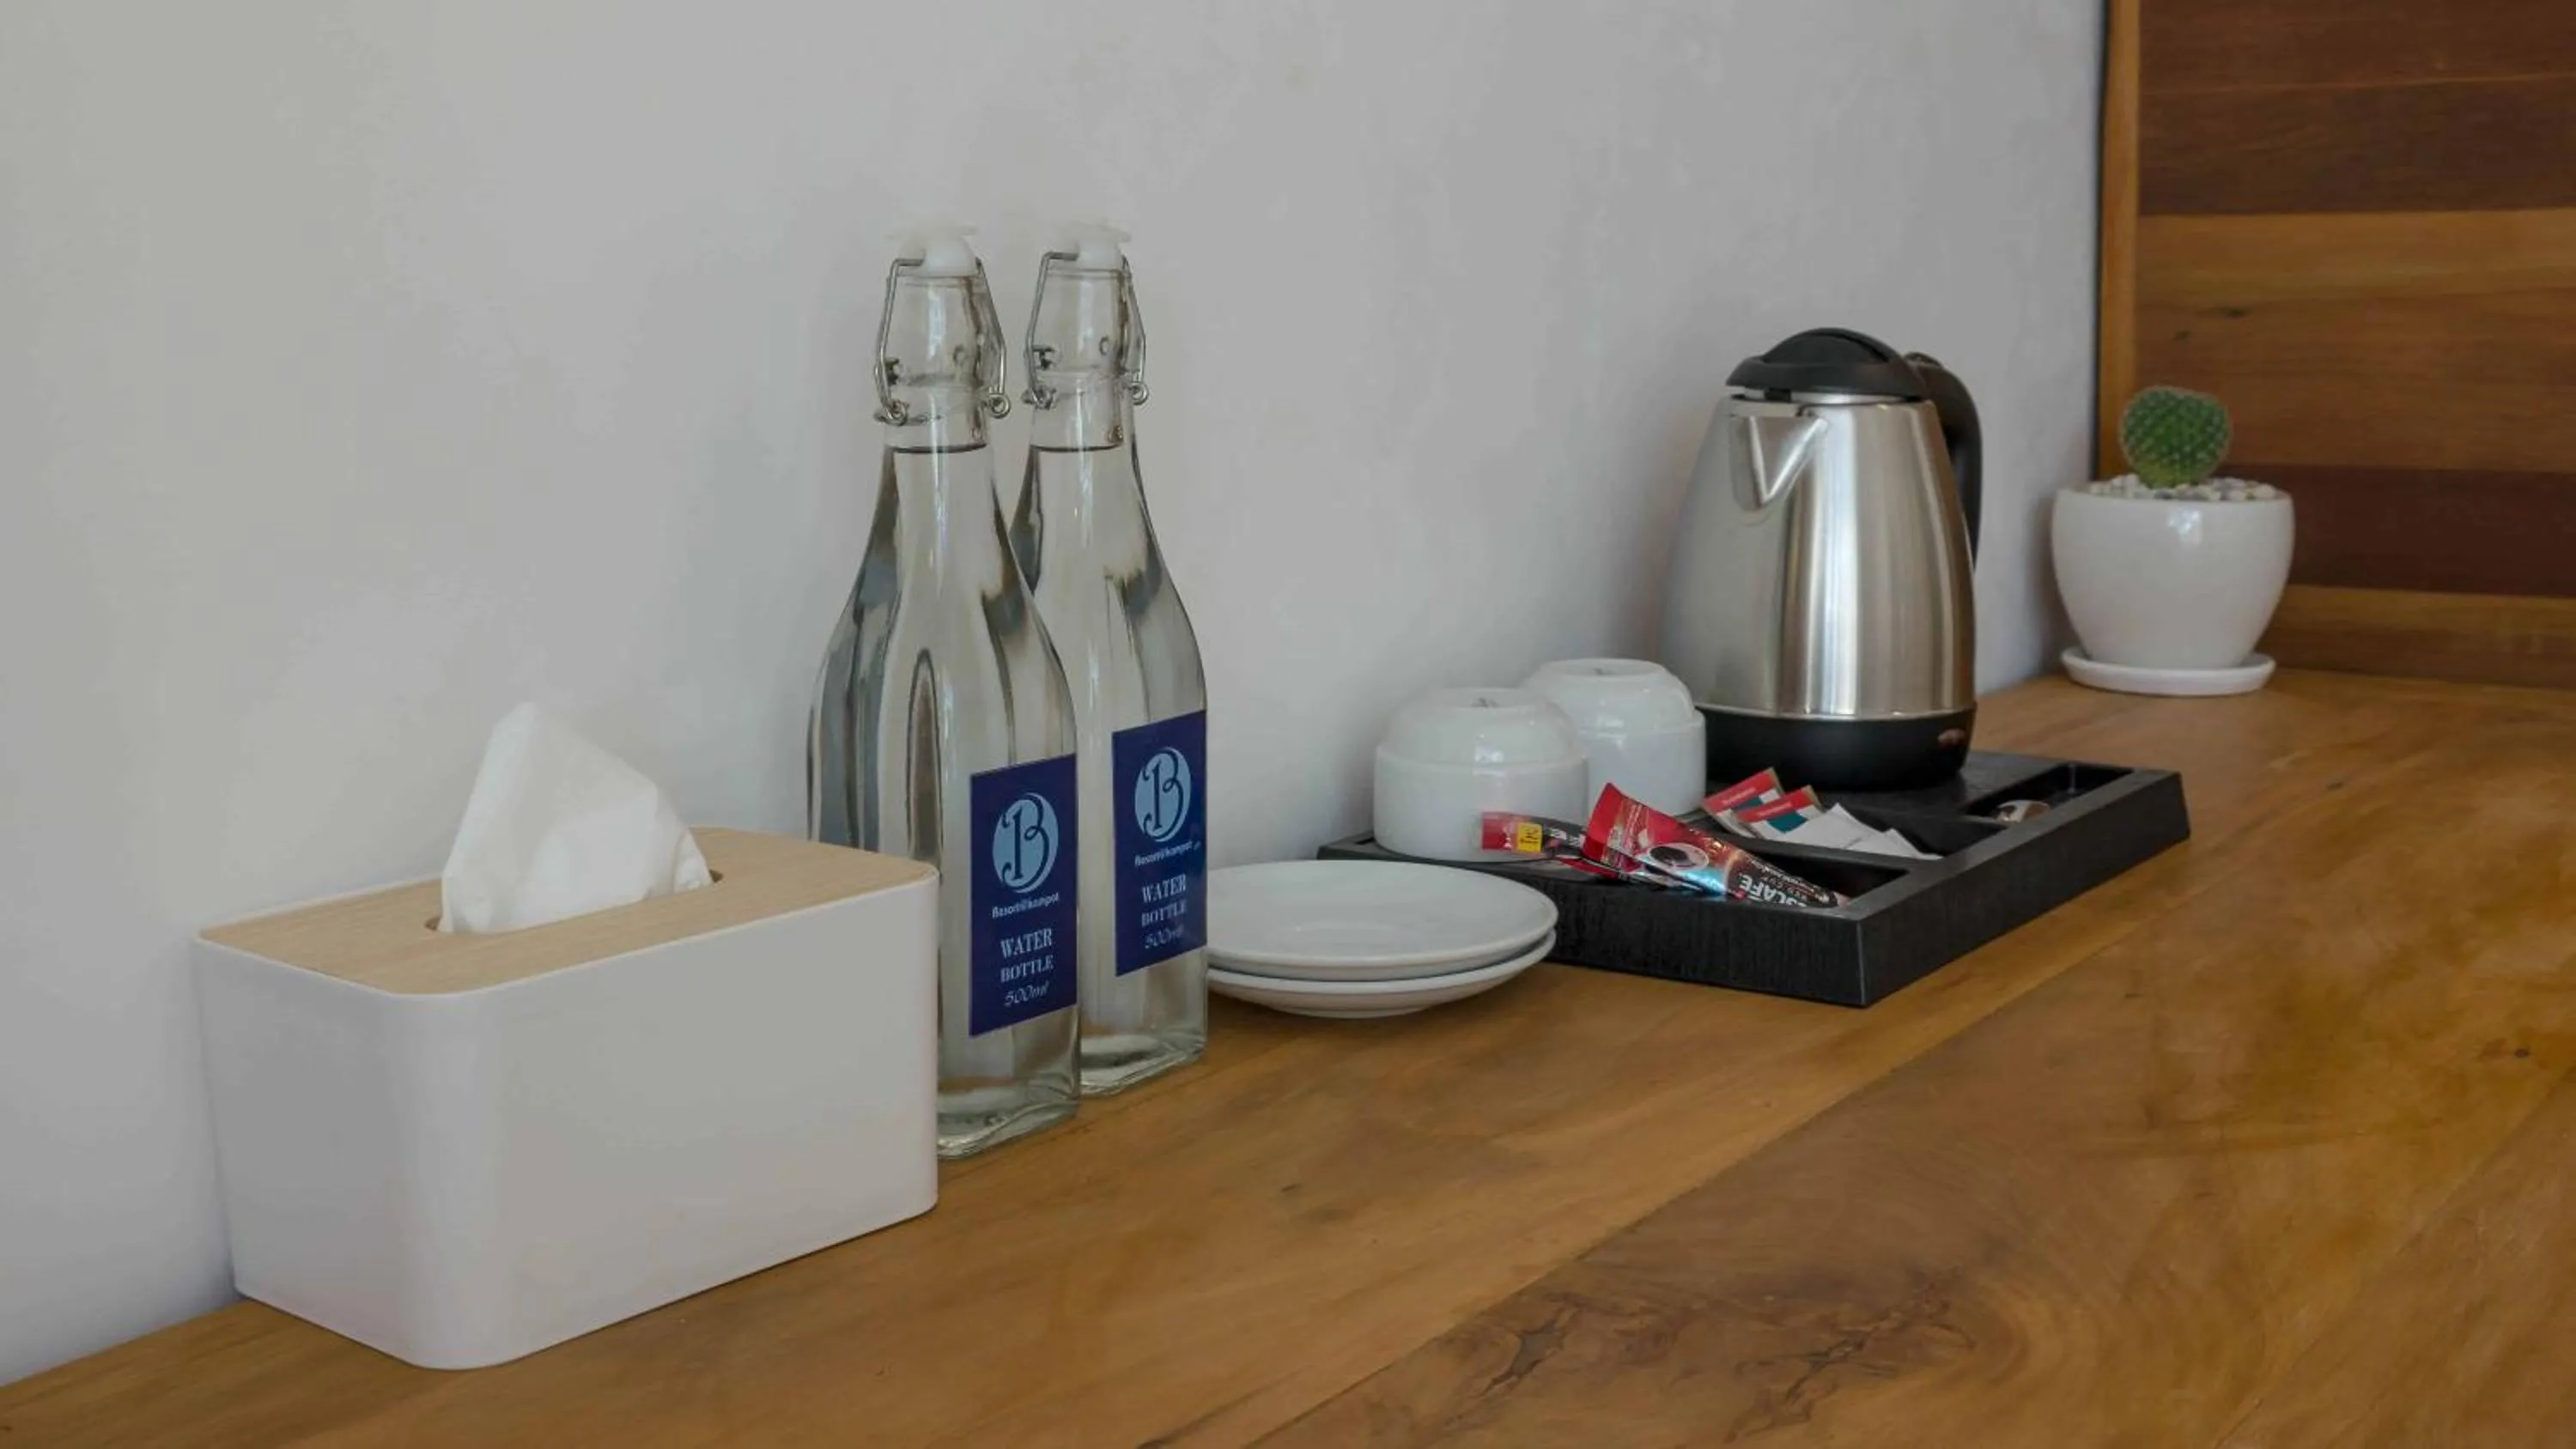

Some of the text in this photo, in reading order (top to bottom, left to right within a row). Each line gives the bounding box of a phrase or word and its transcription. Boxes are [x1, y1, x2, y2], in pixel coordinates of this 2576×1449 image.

[1139, 749, 1185, 840] B
[999, 793, 1051, 892] B
[1141, 874, 1187, 904] WATER
[1141, 899, 1187, 927] BOTTLE
[1000, 928, 1054, 960] WATER
[1000, 955, 1054, 983] BOTTLE
[1004, 980, 1050, 1007] 500ml
